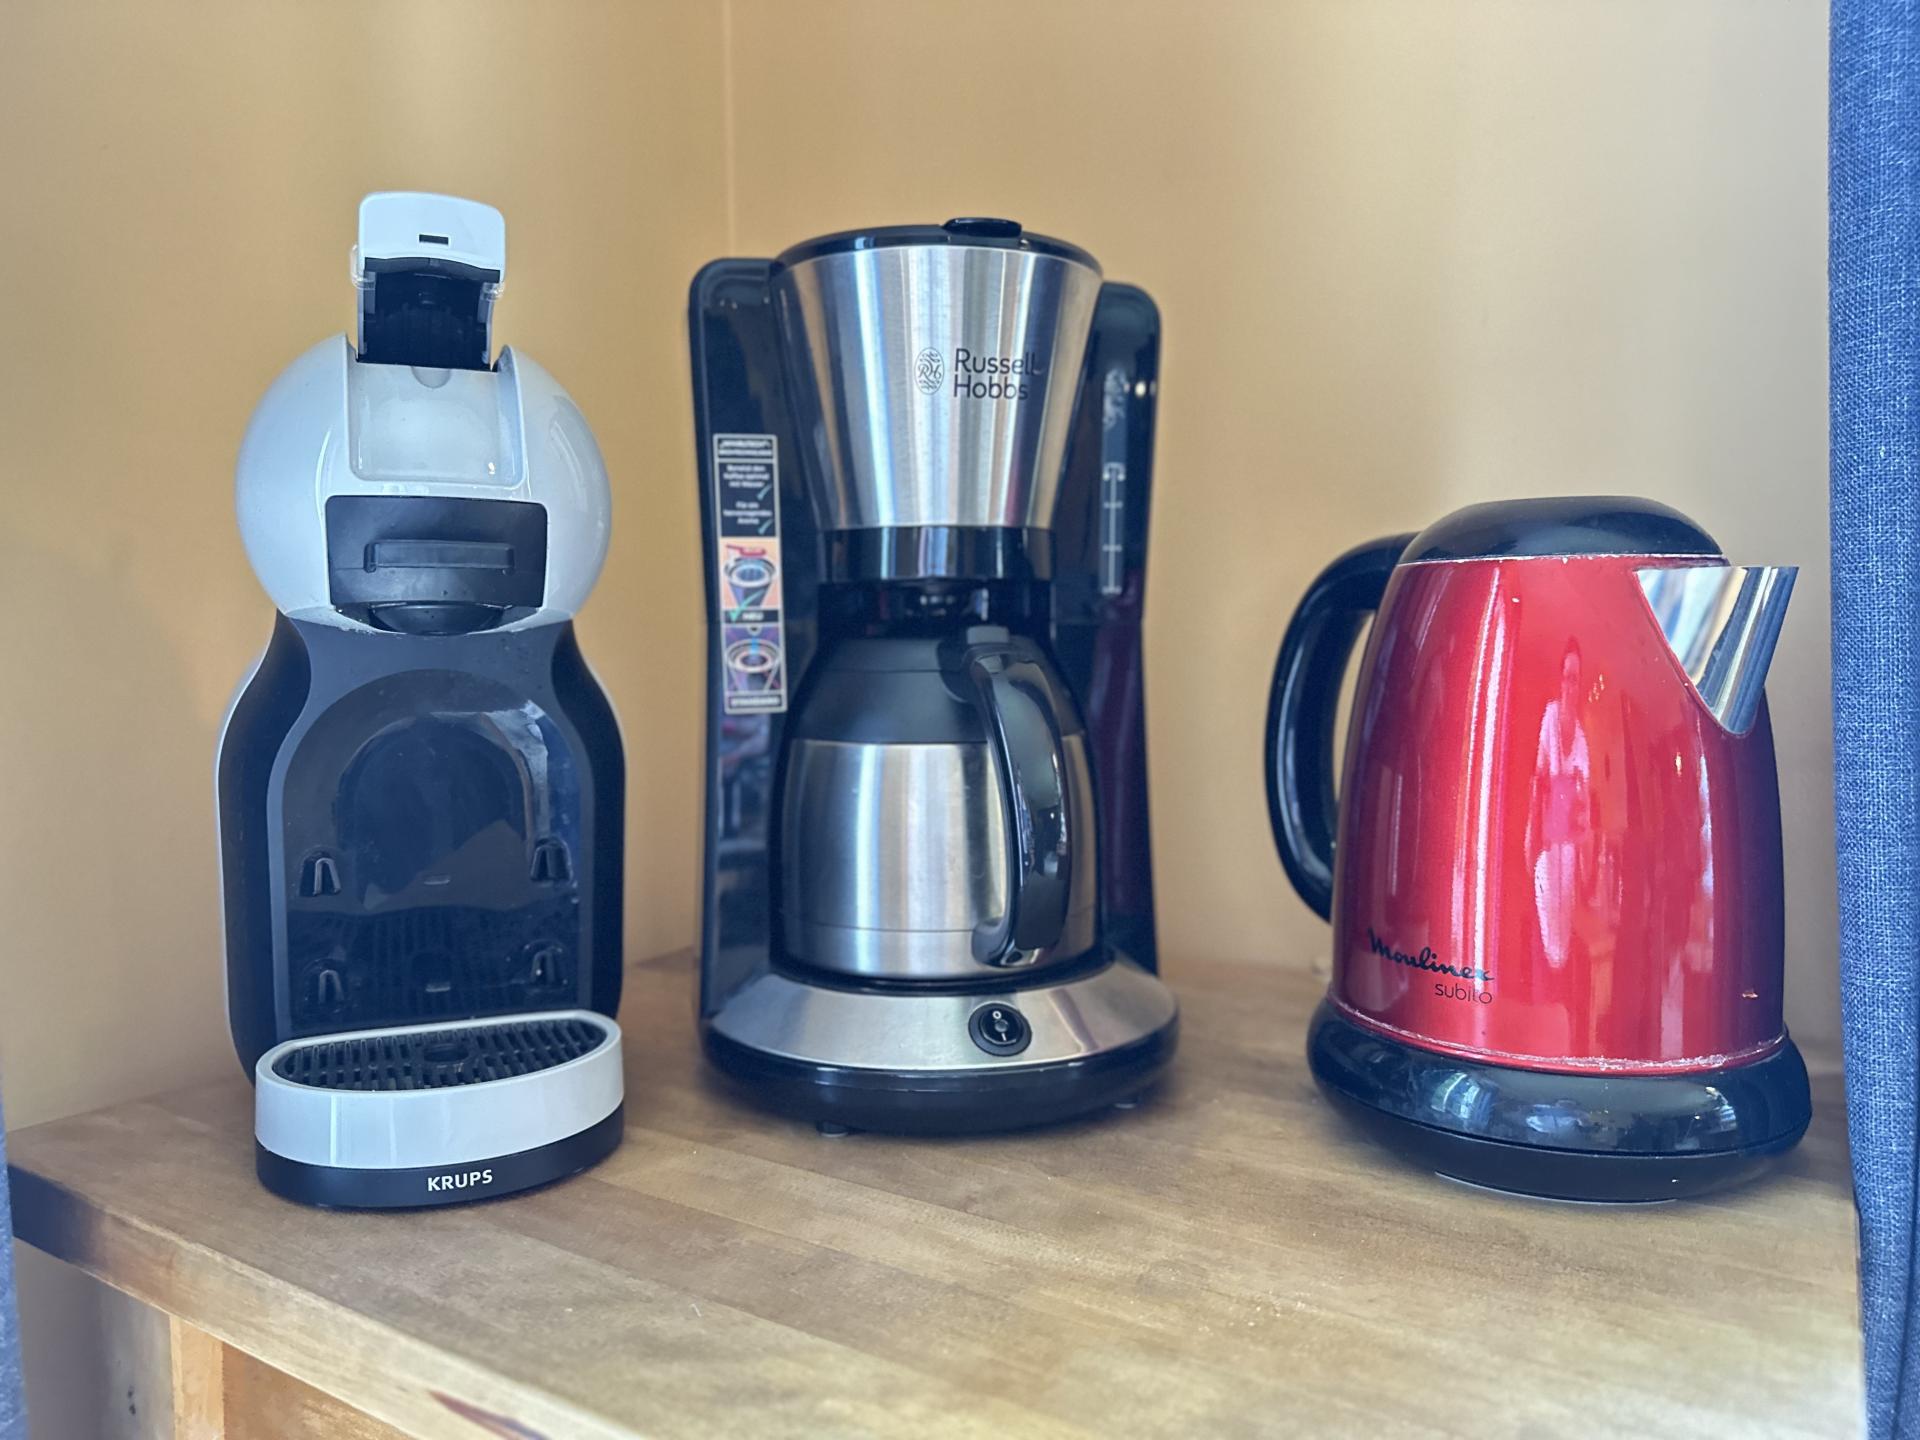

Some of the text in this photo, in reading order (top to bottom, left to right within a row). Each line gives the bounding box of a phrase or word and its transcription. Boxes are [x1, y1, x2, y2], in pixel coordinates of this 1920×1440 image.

[955, 348, 1044, 375] Russell
[953, 374, 1029, 400] Hobbs
[1368, 928, 1495, 981] Moulinex
[427, 1169, 493, 1191] KRUPS
